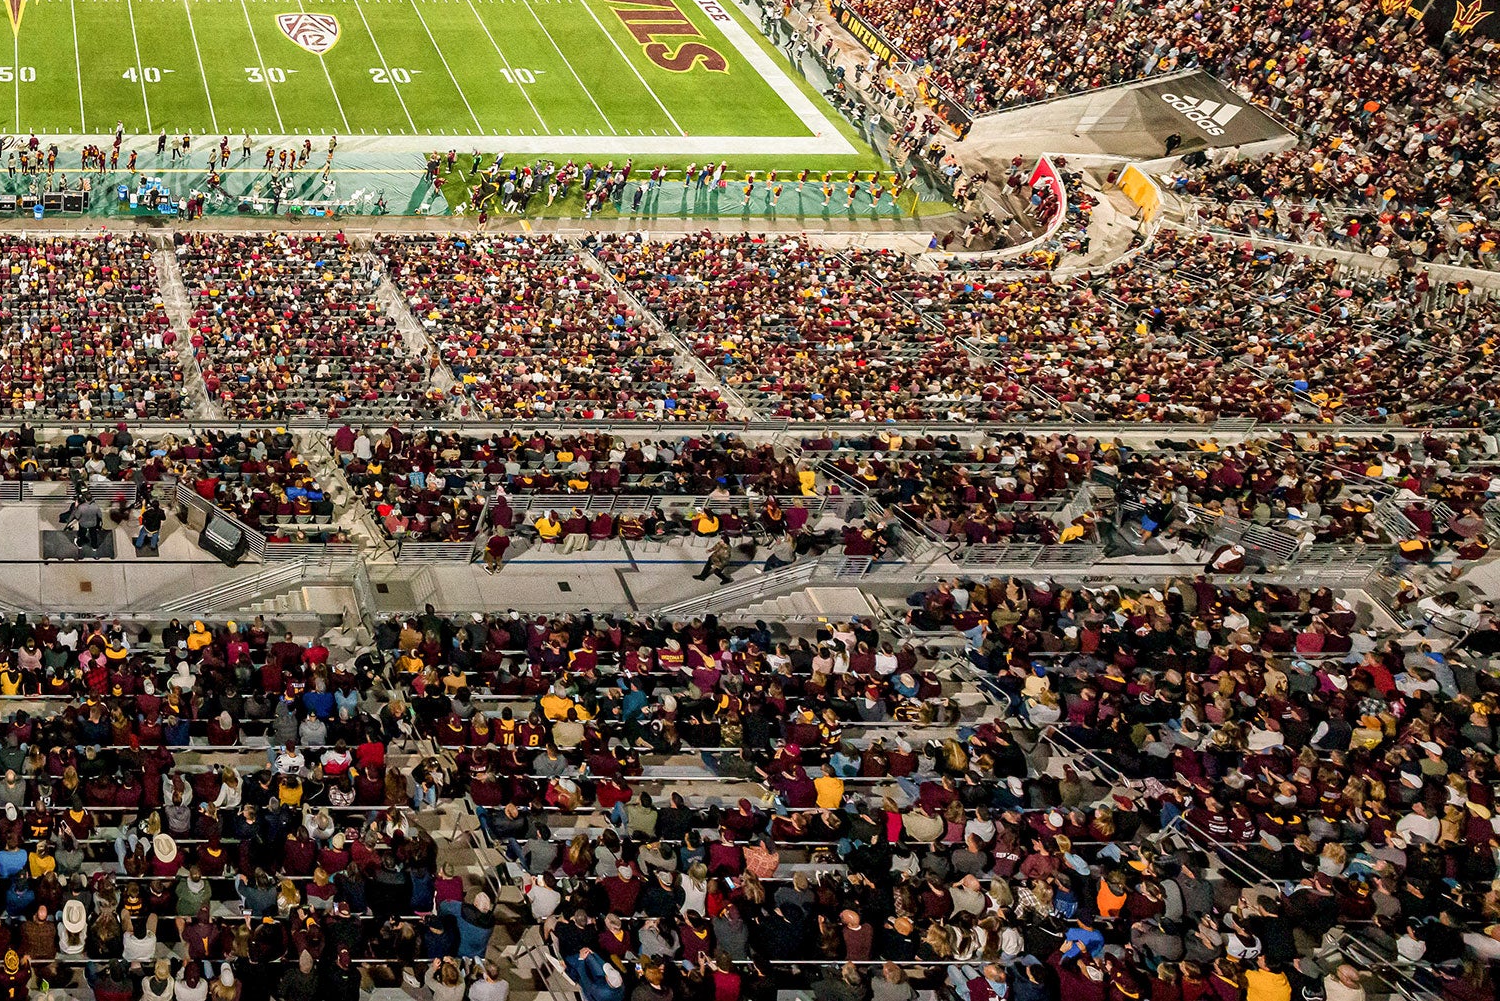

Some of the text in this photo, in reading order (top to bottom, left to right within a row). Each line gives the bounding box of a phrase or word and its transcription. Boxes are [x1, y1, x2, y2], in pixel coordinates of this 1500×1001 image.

[279, 16, 337, 39] PAC
[302, 34, 328, 47] 12
[848, 16, 890, 61] INFERNO
[122, 67, 160, 83] 40
[244, 67, 286, 83] 30
[368, 67, 411, 83] 20
[499, 67, 536, 83] 10
[1160, 93, 1225, 136] adidas
[503, 732, 515, 745] 10
[529, 734, 539, 746] 8
[30, 825, 48, 838] 75
[1238, 949, 1259, 958] 42
